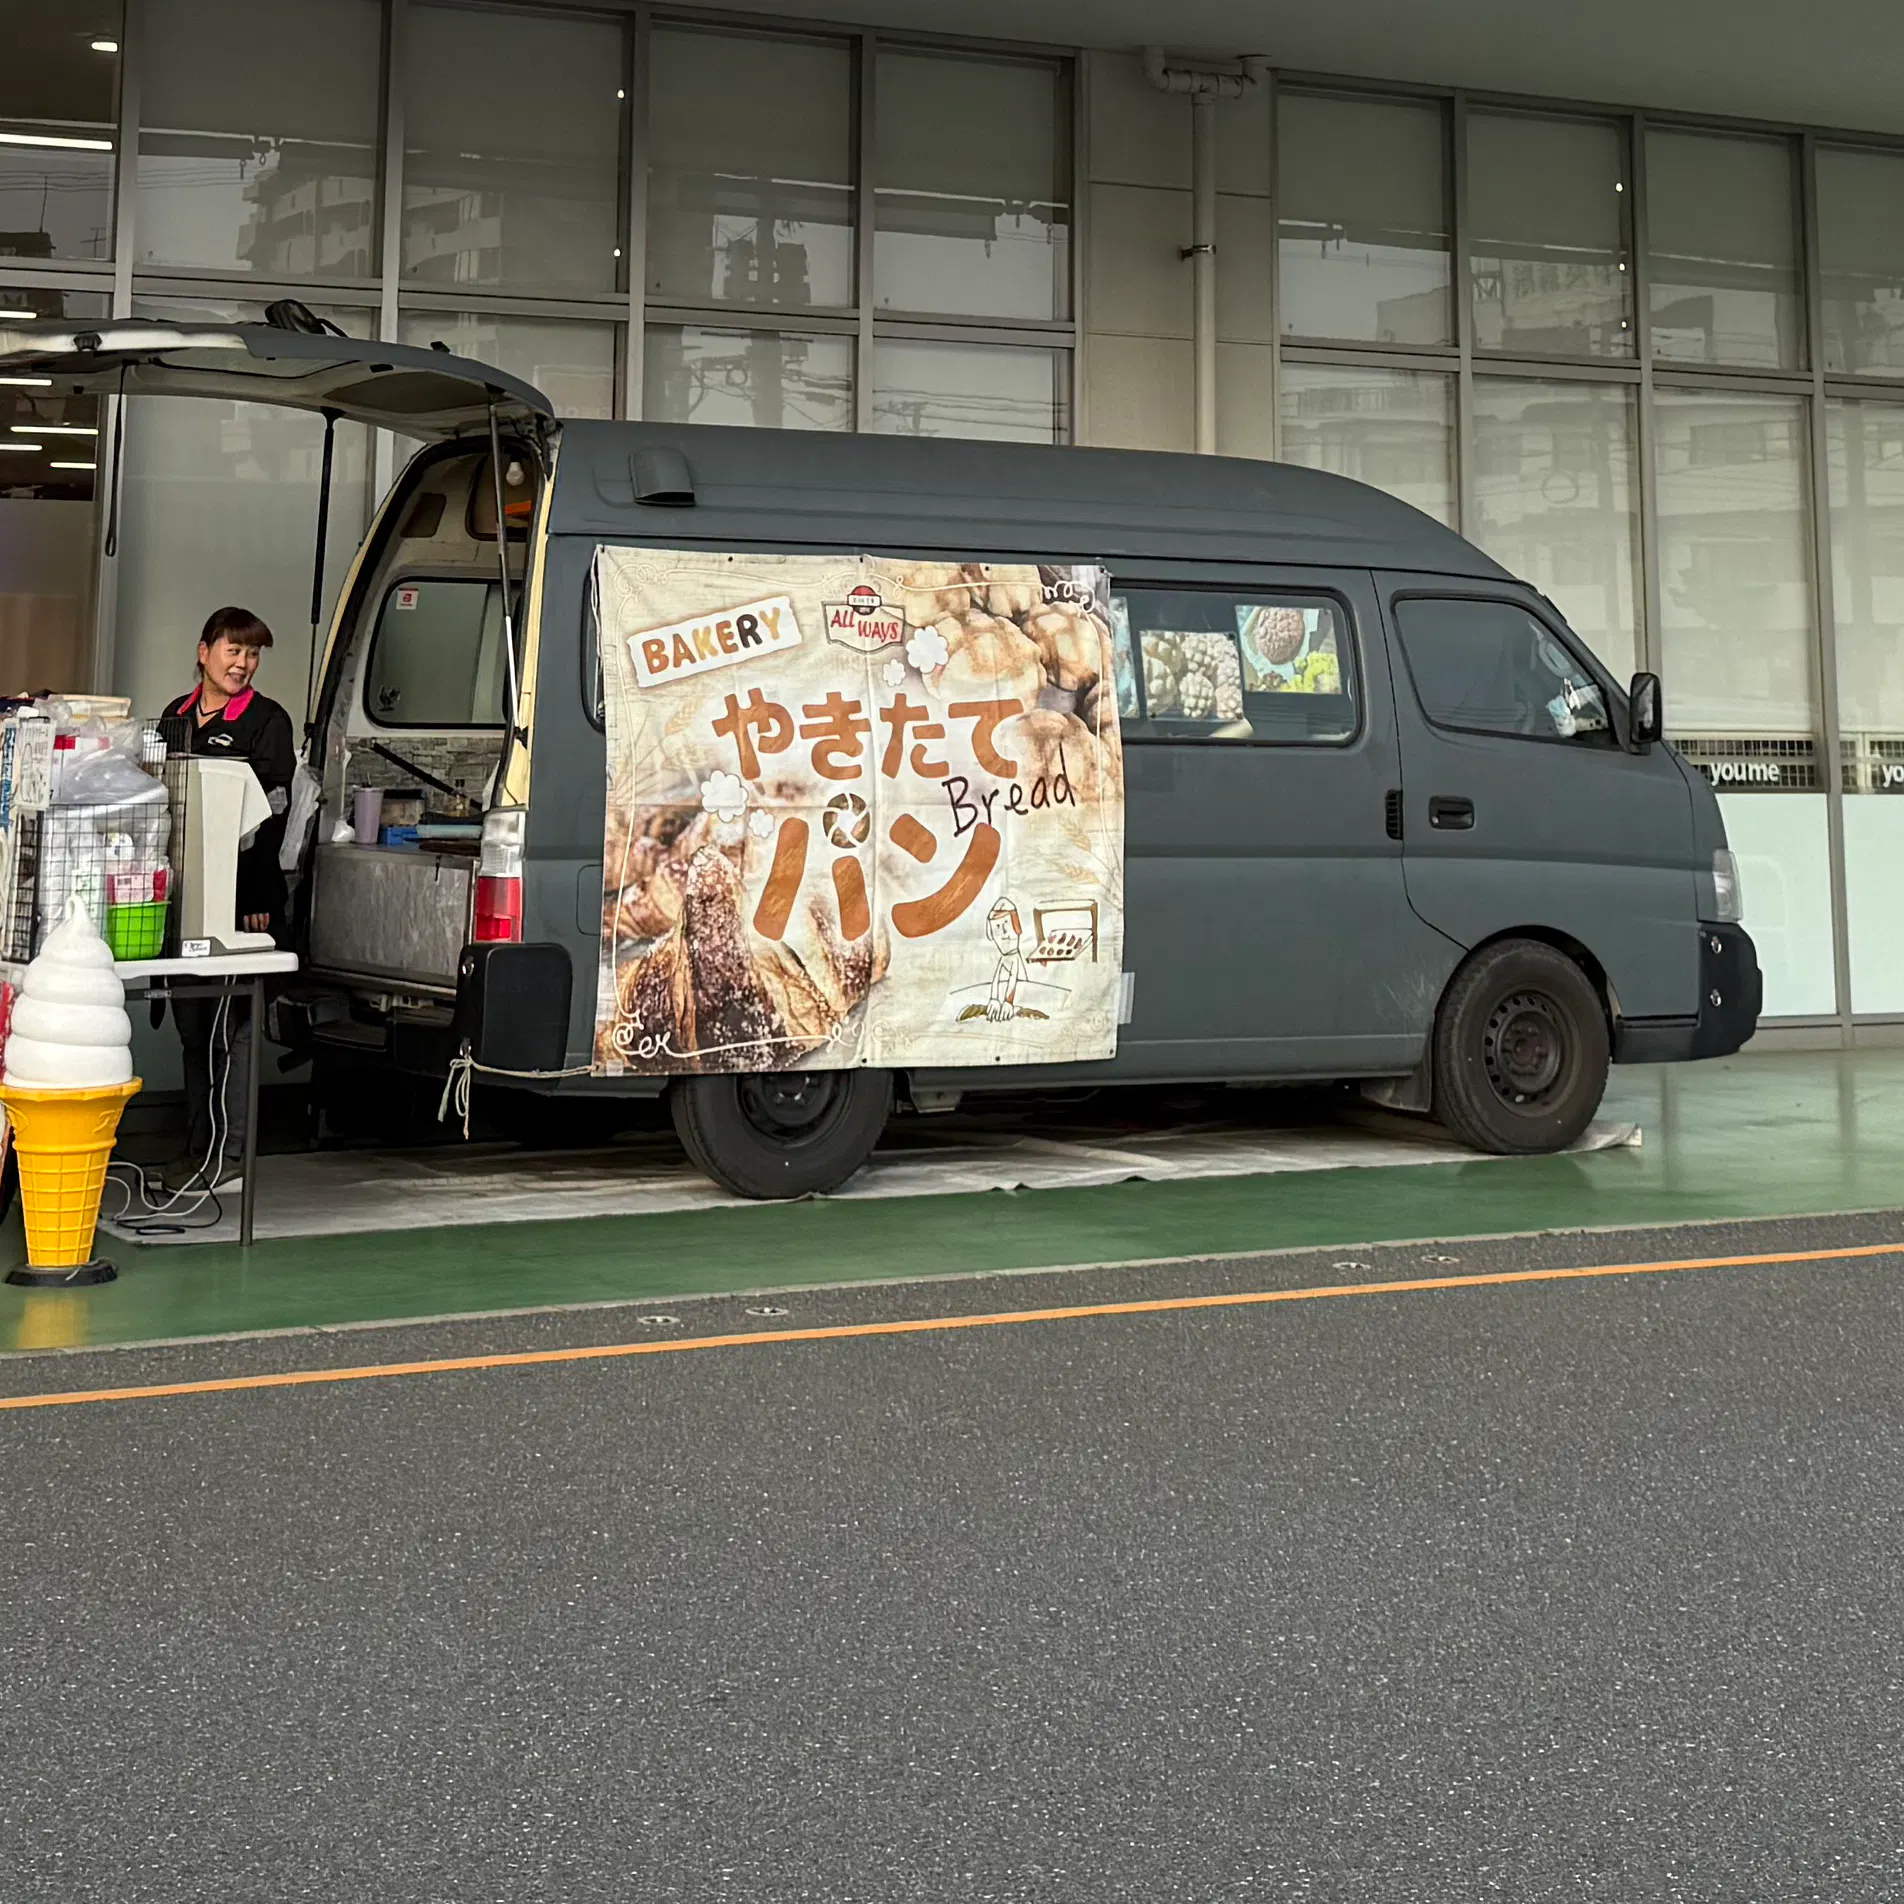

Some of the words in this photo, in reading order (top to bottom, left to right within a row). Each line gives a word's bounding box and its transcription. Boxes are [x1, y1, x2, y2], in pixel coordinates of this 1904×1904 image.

[641, 606, 782, 675] BAKERY
[830, 609, 855, 628] ALL
[858, 620, 899, 643] WAYS
[711, 686, 1024, 781] やきたて
[941, 742, 1076, 837] Bread
[1710, 762, 1780, 787] youme
[752, 793, 1001, 941] パン
